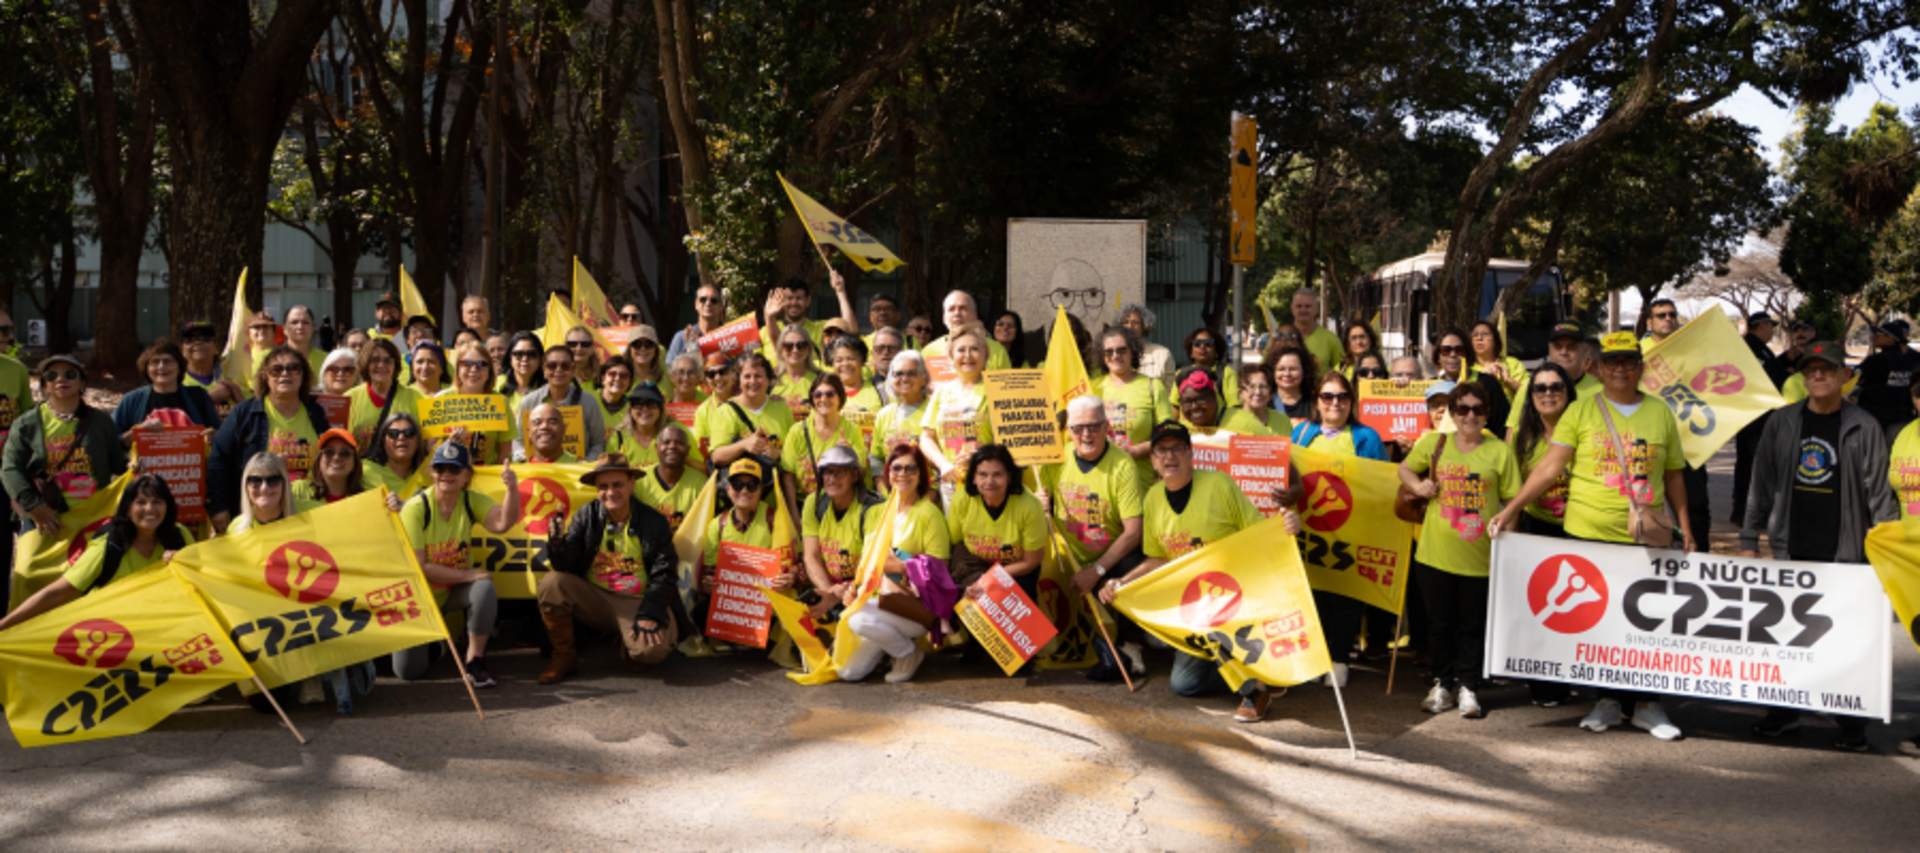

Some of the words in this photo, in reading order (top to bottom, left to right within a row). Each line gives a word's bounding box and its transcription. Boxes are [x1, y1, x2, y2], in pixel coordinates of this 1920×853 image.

[1390, 402, 1429, 415] NACION
[1357, 545, 1398, 567] CUT
[1700, 560, 1817, 589] NÚCLEO
[366, 580, 413, 609] CUT
[975, 590, 1019, 637] NACIONA
[1263, 610, 1305, 638] CUT
[1622, 578, 1833, 648] CPERS
[1010, 628, 1038, 657] PISO
[1625, 633, 1697, 651] SINDICATO
[1700, 641, 1755, 657] FILIADO
[1776, 650, 1815, 664] CNTE
[1575, 641, 1703, 676] FUNCIONÁRIOS
[1709, 657, 1733, 680] NA
[1740, 661, 1787, 686] LUTA.
[1504, 656, 1566, 679] ALEGRETE,
[1570, 662, 1595, 681] SÃO
[1600, 667, 1670, 690] FRANCISCO
[1674, 677, 1690, 692] DE
[1694, 679, 1733, 697] ASSIS
[1741, 684, 1748, 698] E
[1757, 686, 1812, 707] MANOEL
[1821, 693, 1868, 711] VIANA.
